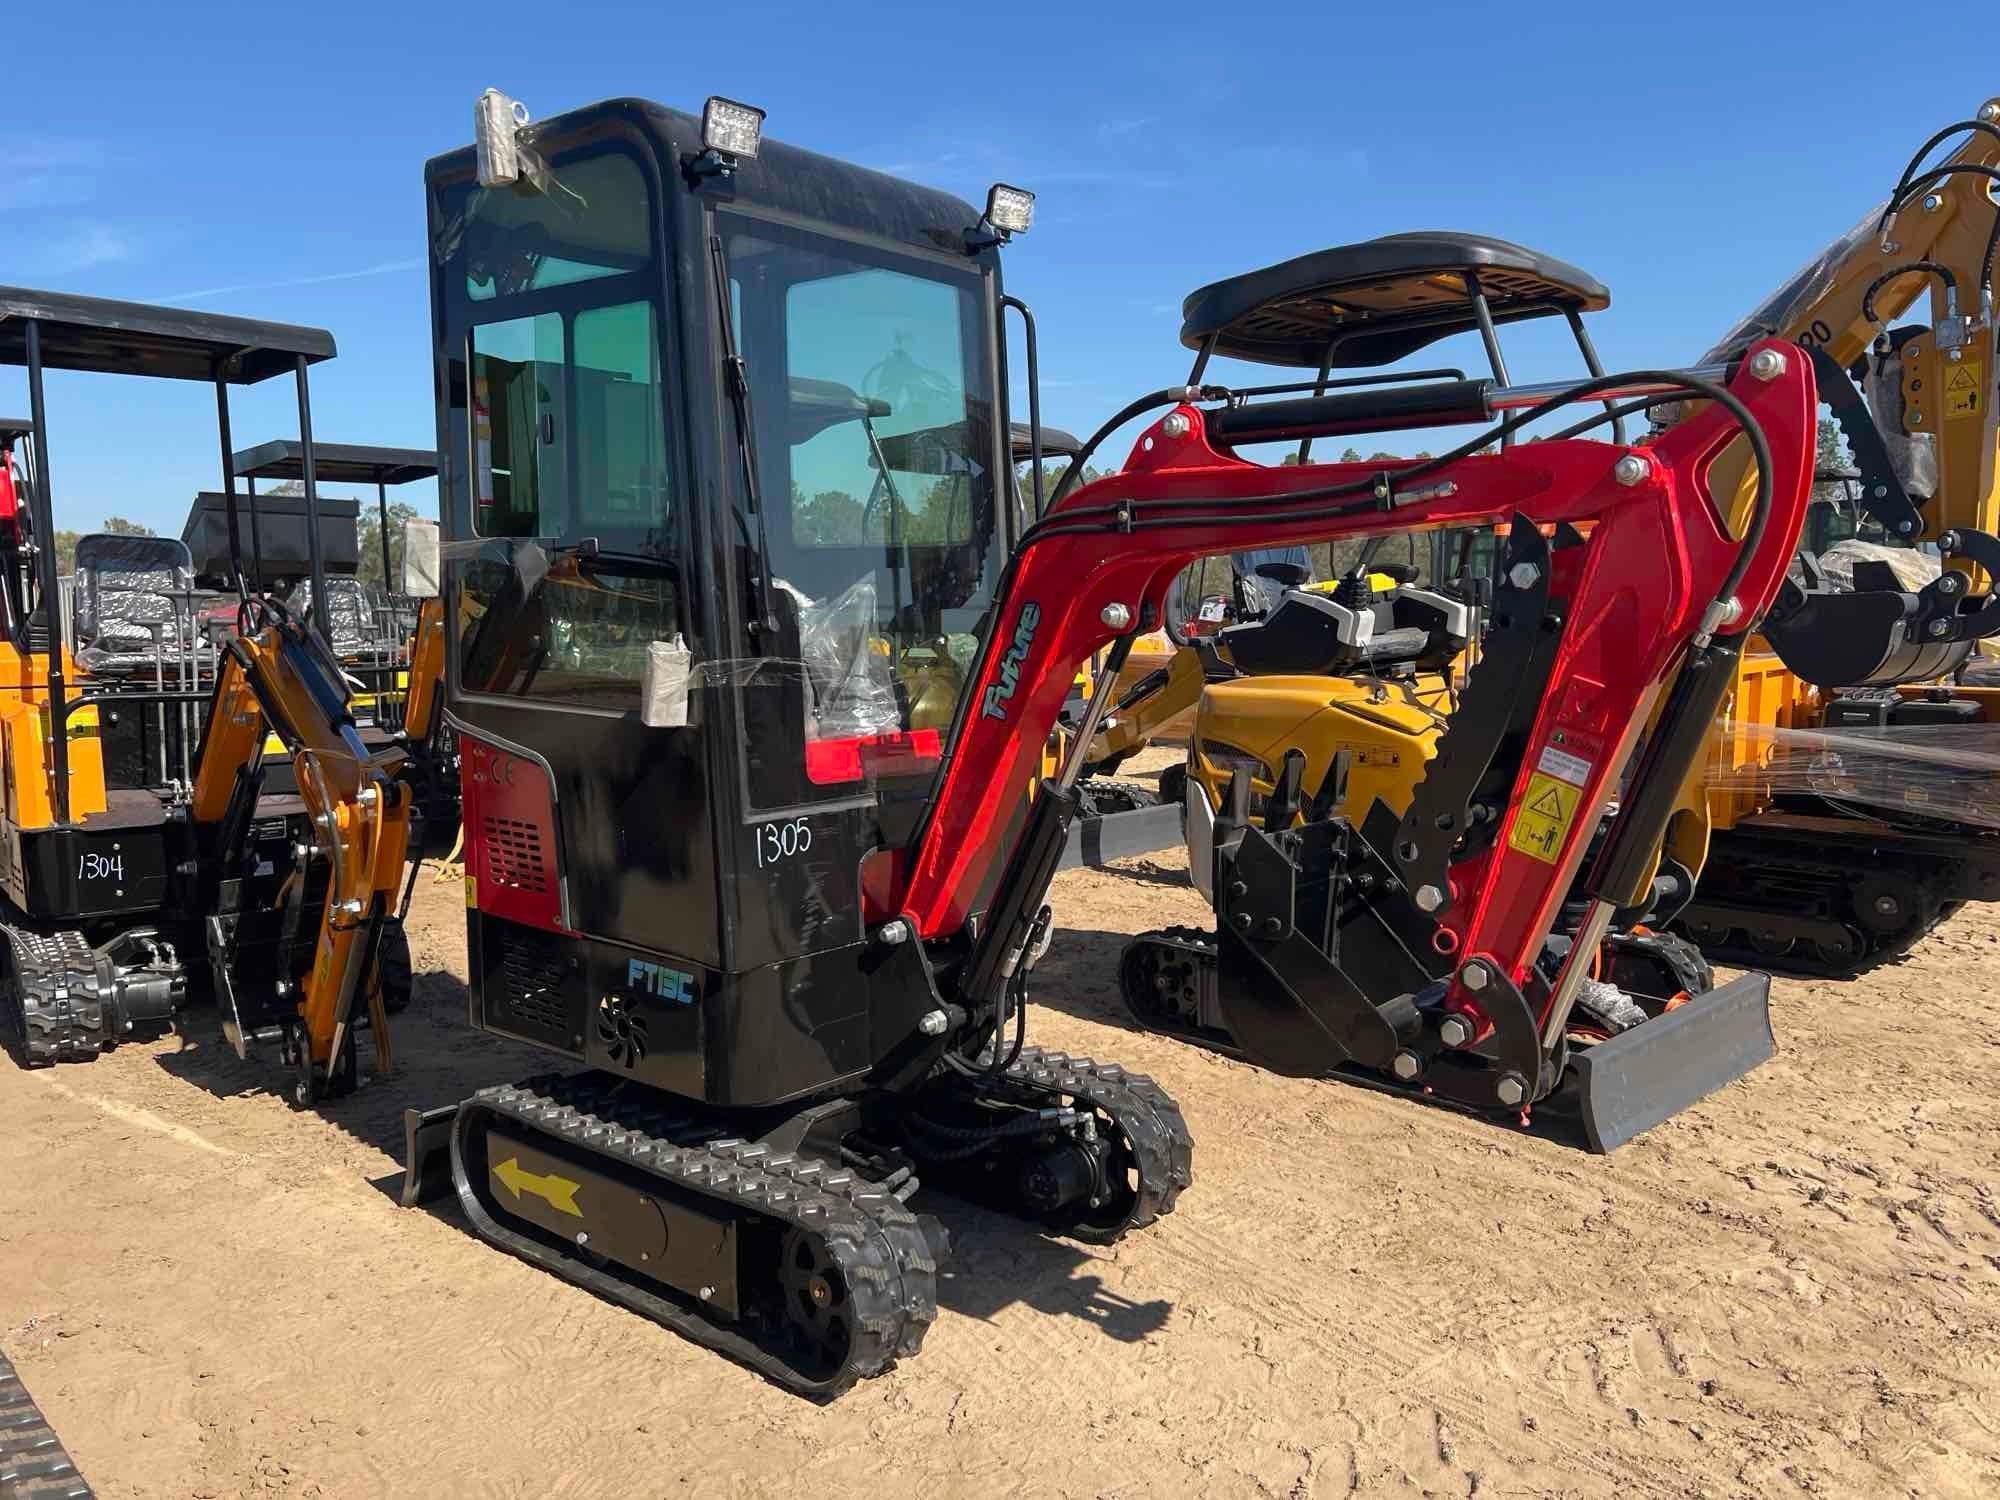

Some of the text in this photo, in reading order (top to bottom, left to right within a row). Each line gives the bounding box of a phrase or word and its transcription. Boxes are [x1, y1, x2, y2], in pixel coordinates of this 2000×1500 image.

[982, 602, 1041, 720] Future
[78, 853, 124, 881] 1304
[756, 817, 812, 868] 1305
